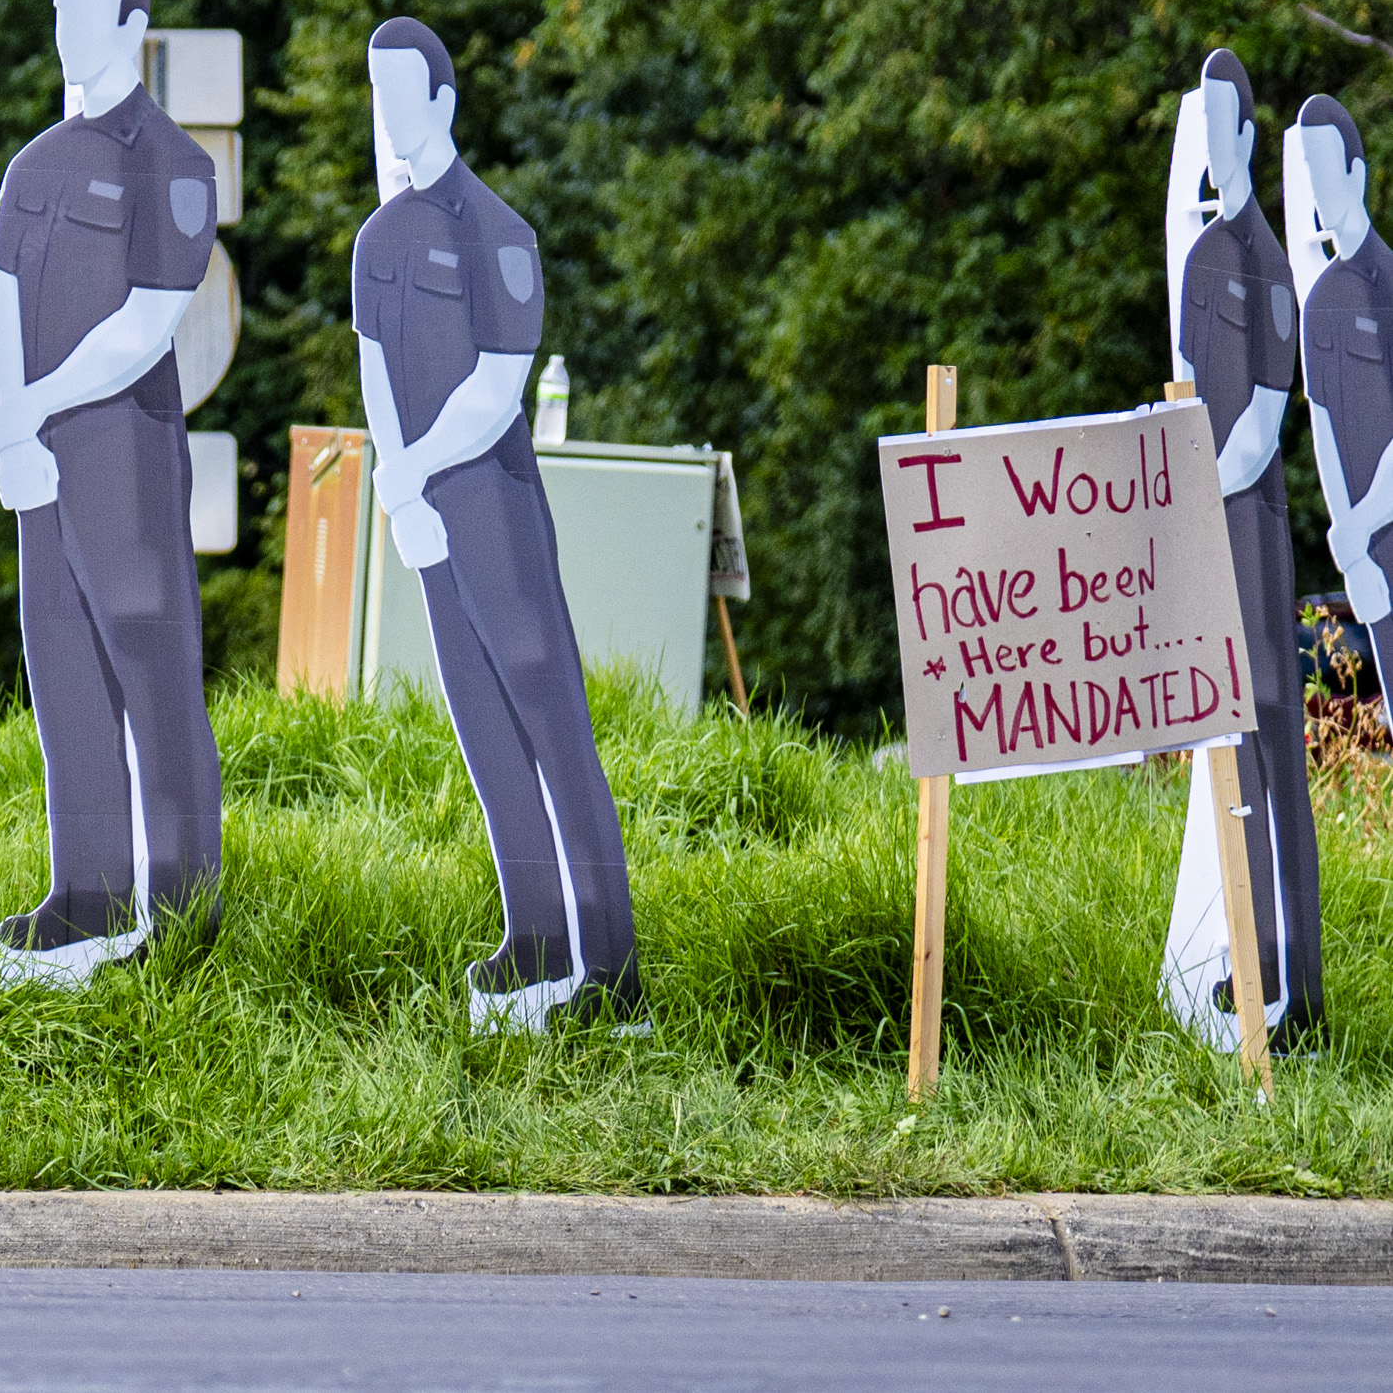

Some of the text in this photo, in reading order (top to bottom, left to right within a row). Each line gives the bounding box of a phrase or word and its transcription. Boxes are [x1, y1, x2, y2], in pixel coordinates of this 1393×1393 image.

[897, 427, 1173, 533] I Would
[910, 561, 1039, 642] have
[953, 636, 1242, 764] MANDATED!
[958, 632, 1064, 679] Here
